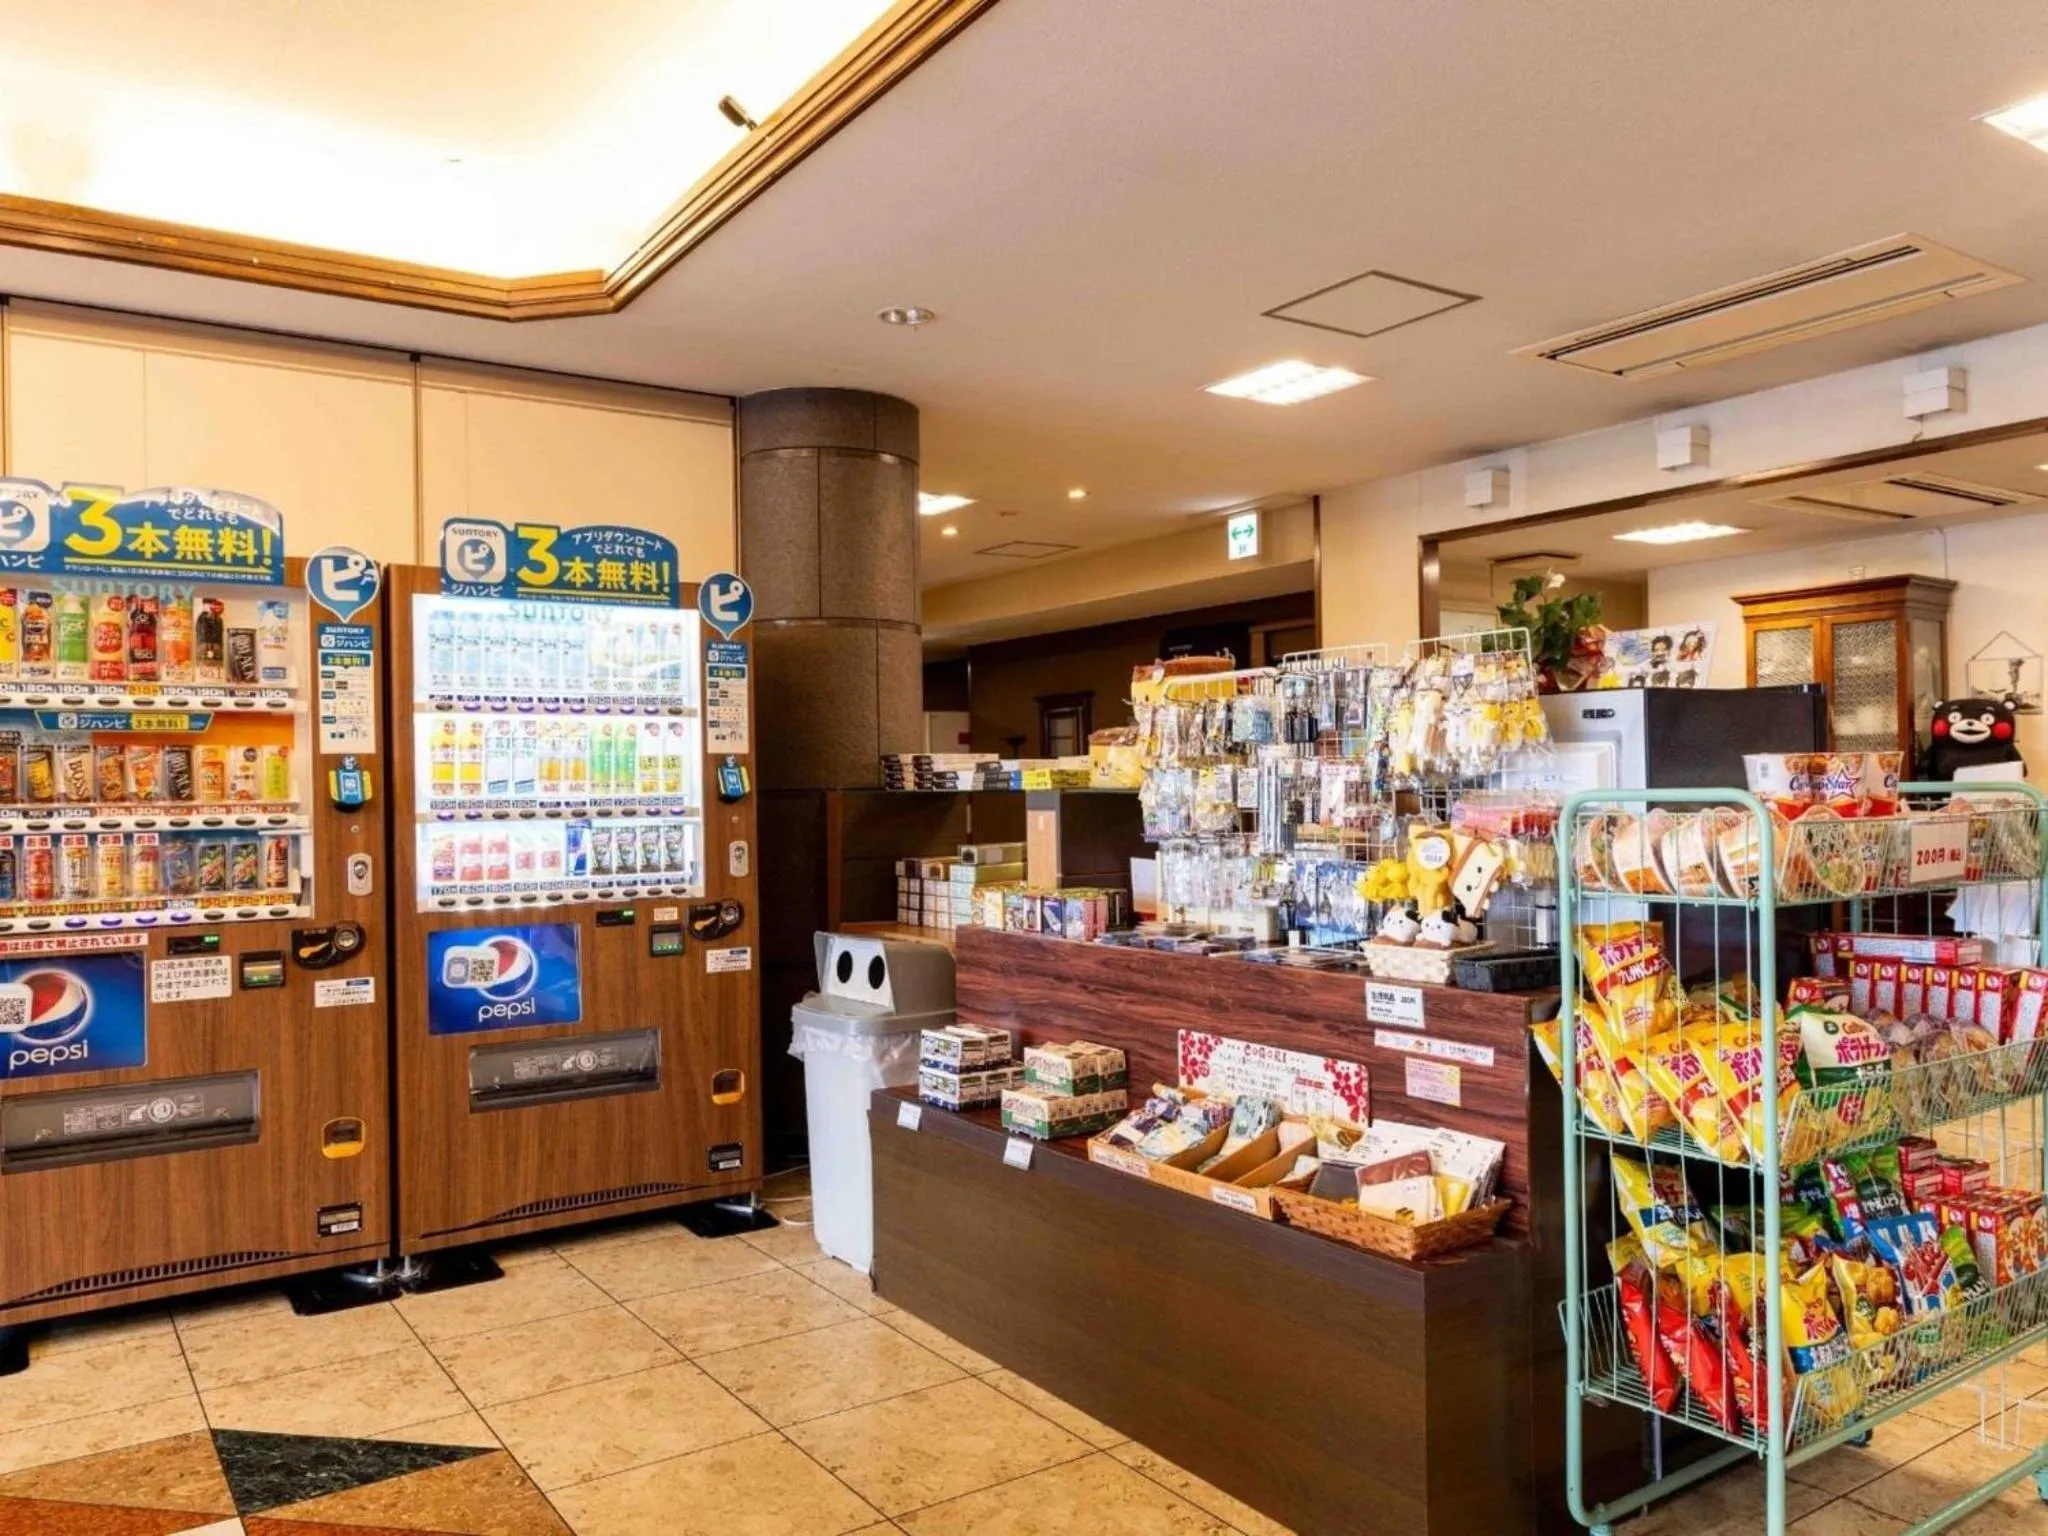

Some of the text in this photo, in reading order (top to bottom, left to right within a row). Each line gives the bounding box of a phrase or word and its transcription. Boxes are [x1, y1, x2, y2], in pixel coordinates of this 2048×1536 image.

[452, 528, 499, 538] SUNTORY
[516, 525, 671, 593] 3本無料!
[592, 543, 646, 559] でどれでも
[52, 578, 195, 601] SUNTORY
[508, 602, 614, 624] SUNTORY
[79, 716, 127, 729] ジハンピ
[1916, 847, 1945, 866] 200円
[478, 997, 536, 1023] pepsi
[9, 1039, 89, 1071] pepsi
